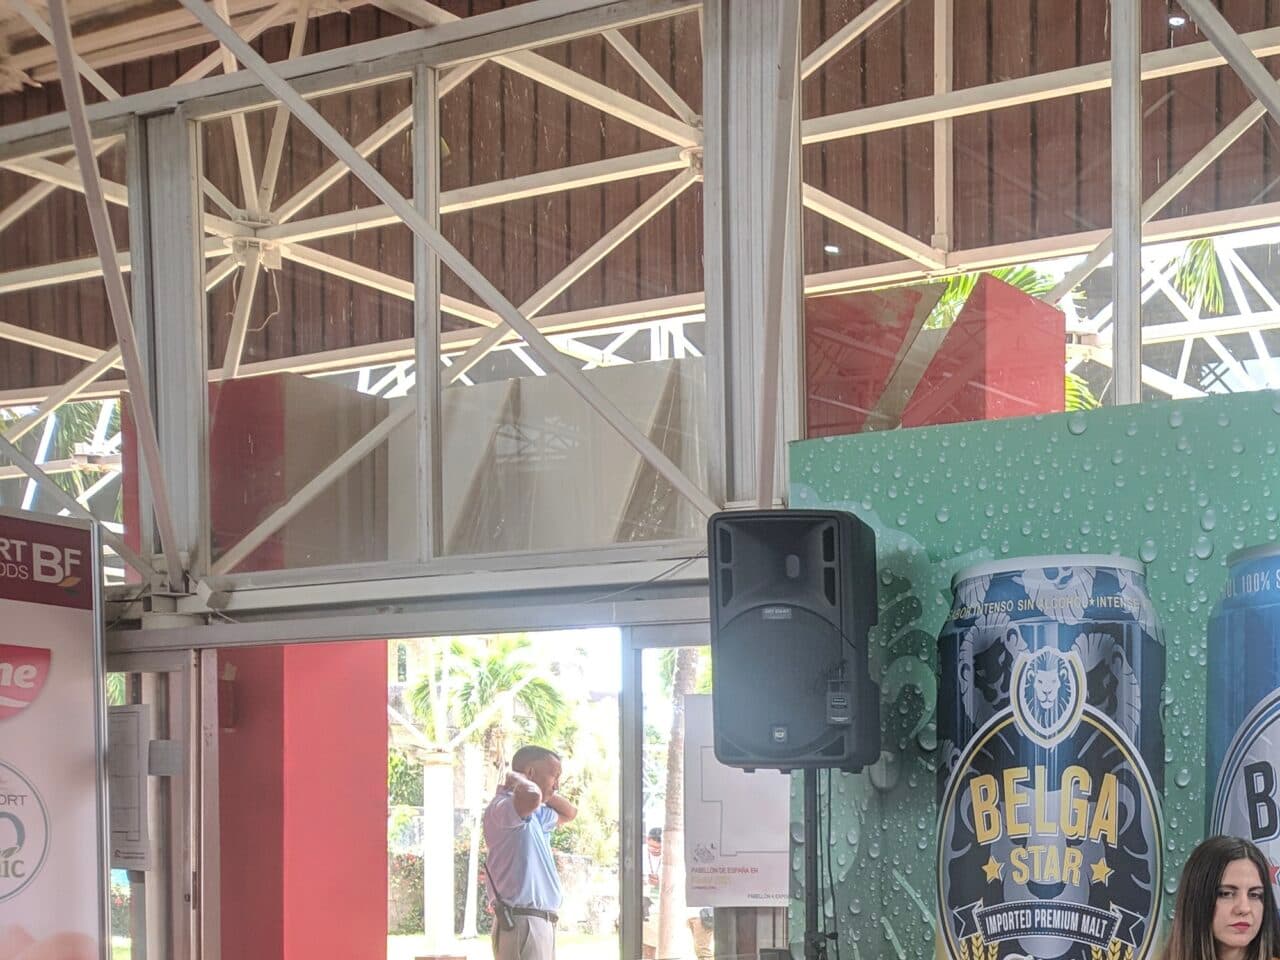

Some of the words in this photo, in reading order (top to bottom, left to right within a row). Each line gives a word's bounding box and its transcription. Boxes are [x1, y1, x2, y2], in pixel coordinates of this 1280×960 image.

[32, 542, 82, 584] BF
[1242, 570, 1271, 593] 100%
[973, 600, 1014, 615] INTENSO
[1017, 598, 1034, 611] SIN
[970, 765, 1118, 848] BELGA
[1010, 844, 1084, 887] STAR
[986, 909, 1032, 935] IMPORTED
[1035, 908, 1079, 934] PREMIUM
[1081, 915, 1108, 939] MALT
